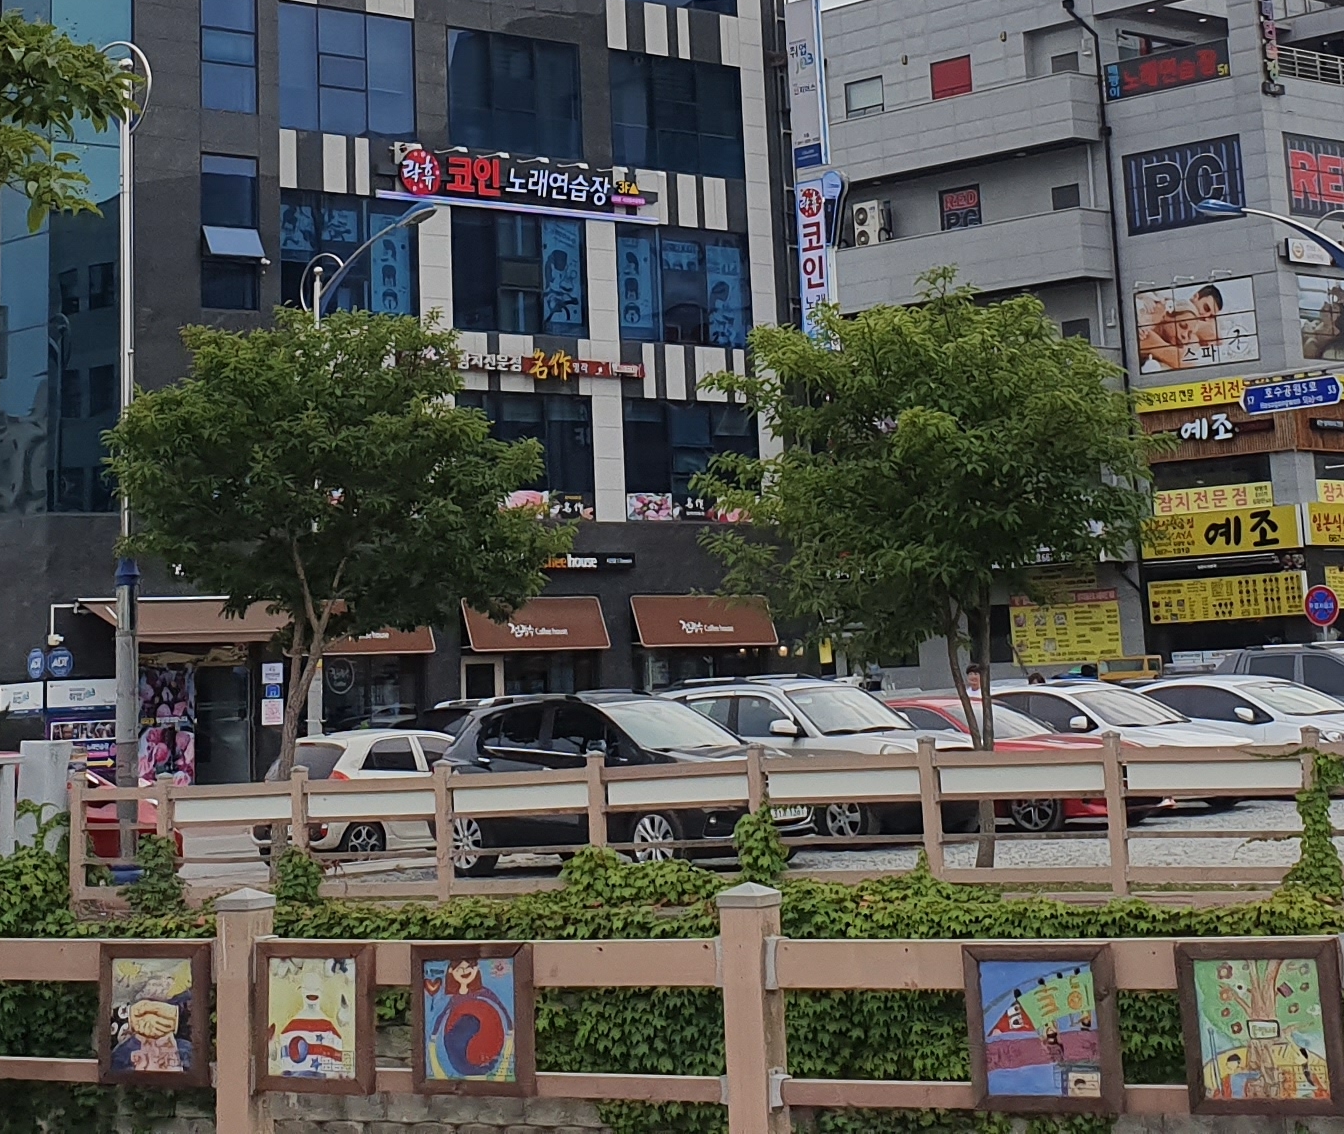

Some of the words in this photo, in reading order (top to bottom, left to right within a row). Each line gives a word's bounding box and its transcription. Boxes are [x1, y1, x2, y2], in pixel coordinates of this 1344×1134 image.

[446, 156, 501, 197] 코인
[505, 167, 610, 206] 노래연습장
[618, 180, 630, 194] 3F
[943, 189, 978, 211] RED
[945, 208, 979, 230] PC
[802, 221, 824, 290] 코인
[1182, 344, 1217, 362] 스파
[1200, 379, 1244, 402] 참치전
[1180, 413, 1233, 441] 예조
[1158, 486, 1248, 513] 참치전문점
[1204, 510, 1280, 548] 예조
[567, 554, 598, 569] house
